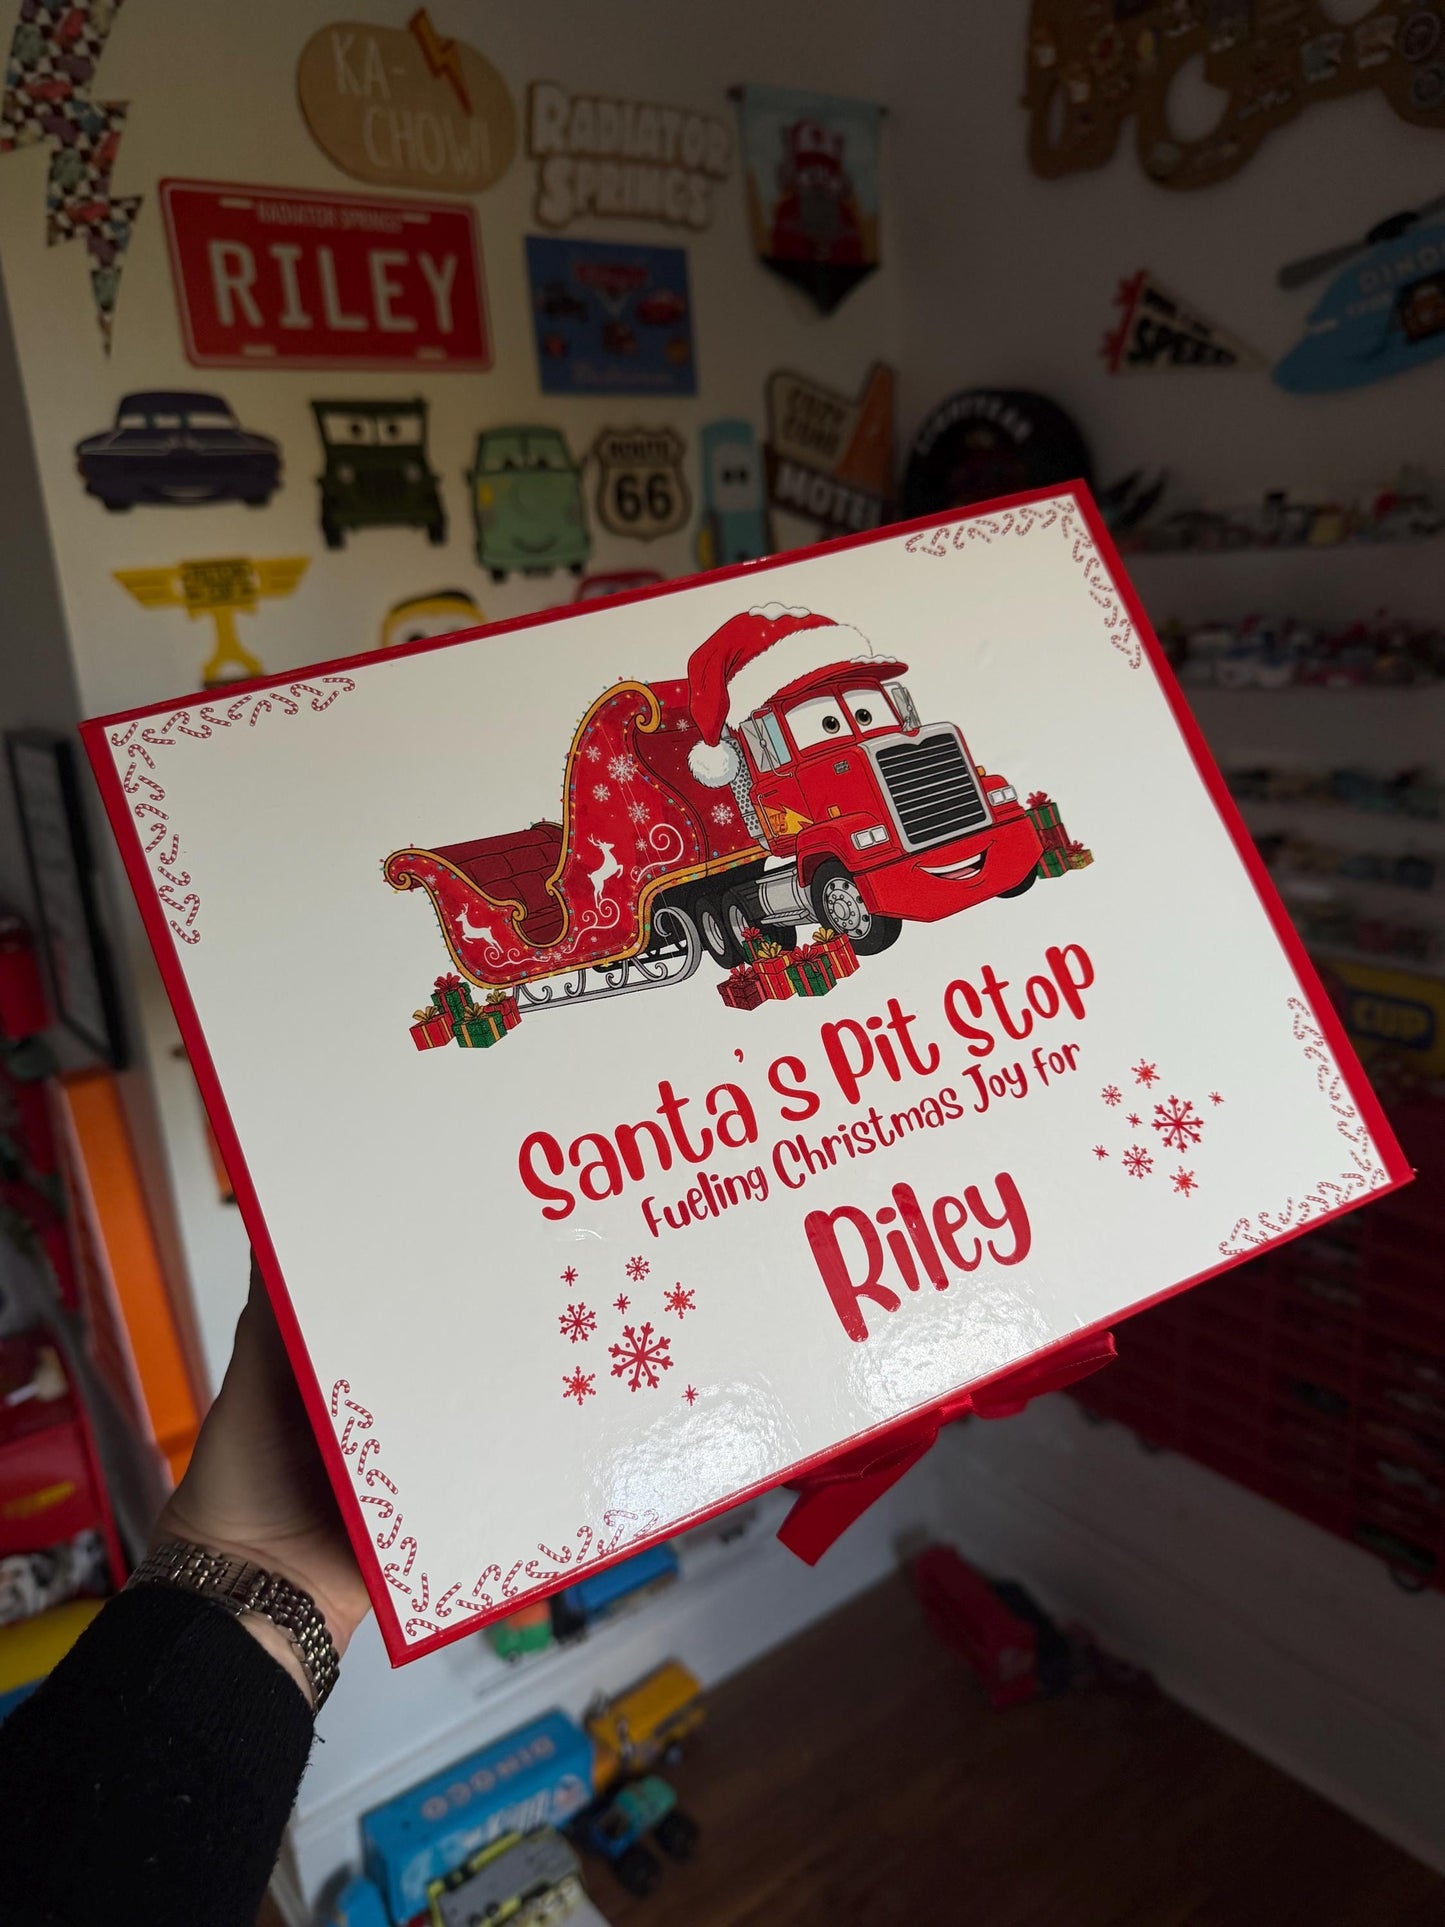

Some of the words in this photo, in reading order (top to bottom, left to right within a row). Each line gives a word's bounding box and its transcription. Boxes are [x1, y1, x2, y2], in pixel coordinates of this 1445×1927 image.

[529, 81, 734, 182] RADIATOR
[536, 156, 714, 231] SPRINGS
[206, 238, 460, 336] RILEY
[616, 473, 673, 522] 66
[517, 1048, 821, 1222] Santa's
[819, 997, 941, 1106] Pit
[943, 943, 1095, 1058] Stop
[772, 1083, 964, 1190] Christmas
[962, 1062, 1029, 1114] Joy
[803, 1171, 1033, 1343] Riley
